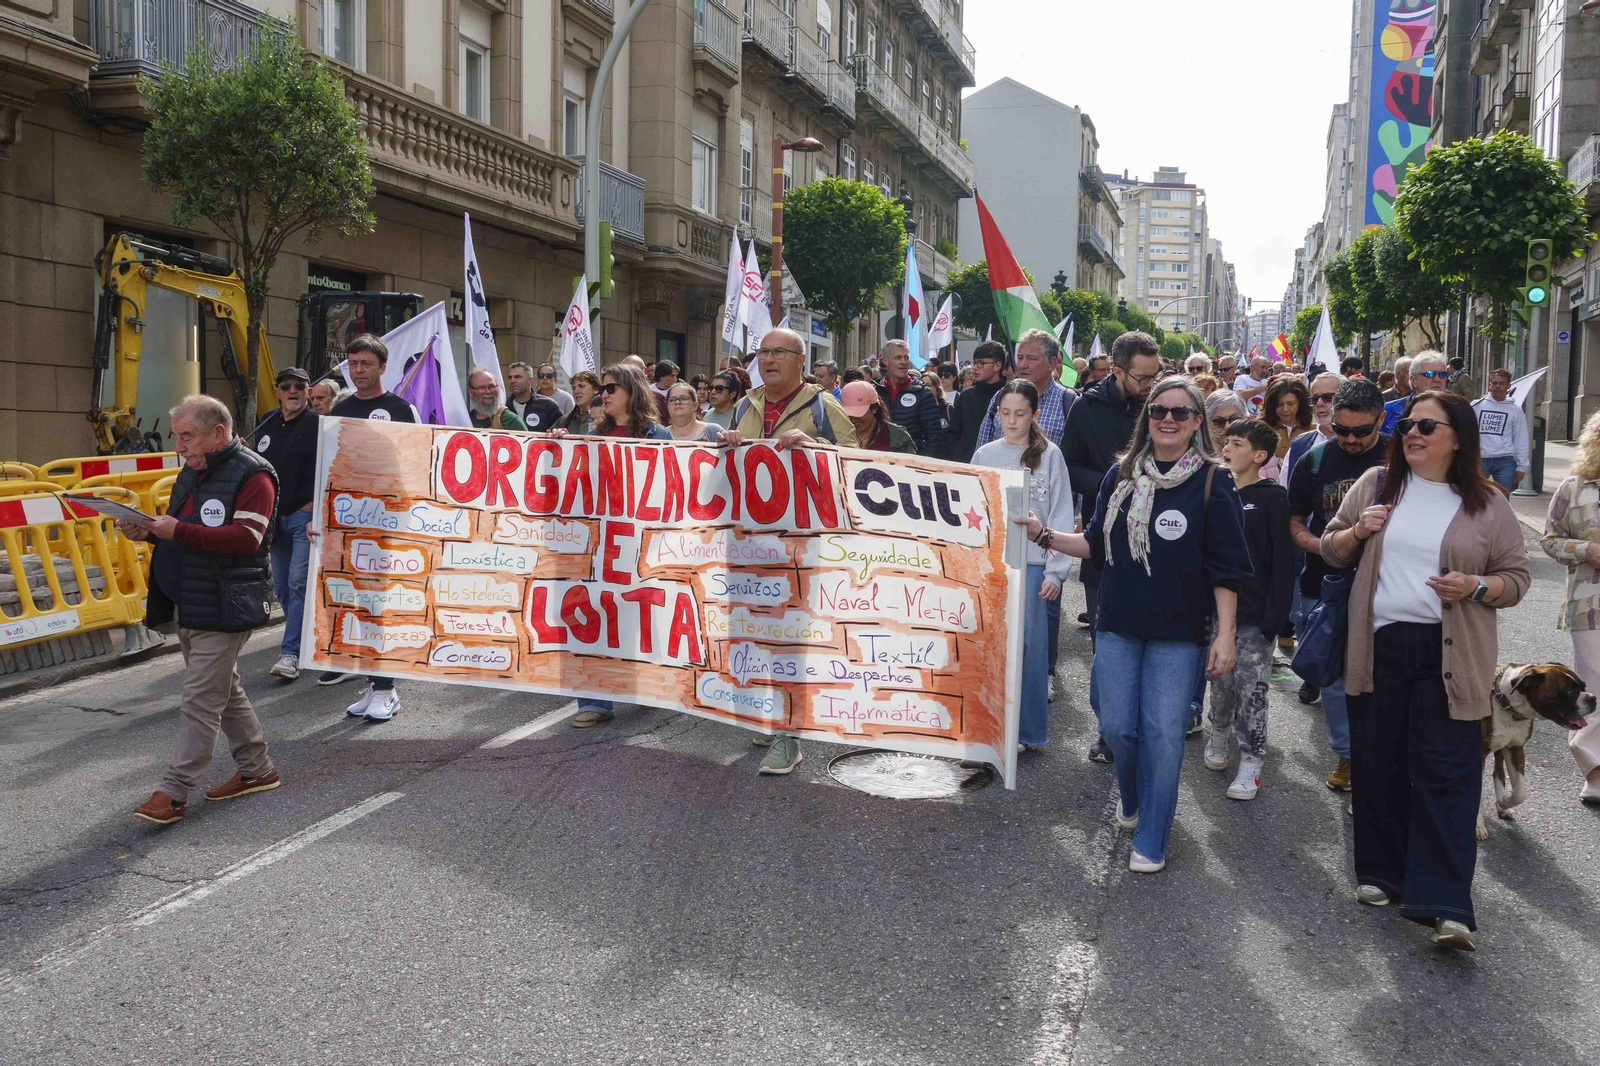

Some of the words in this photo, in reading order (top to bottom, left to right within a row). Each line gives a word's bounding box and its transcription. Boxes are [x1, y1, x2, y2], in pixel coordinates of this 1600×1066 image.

[308, 275, 351, 291] nta4banco
[336, 497, 398, 530] Política
[406, 505, 463, 535] Social
[497, 516, 582, 546] Sanidade
[356, 542, 420, 572] Ensino
[450, 544, 527, 570] Loxística
[604, 521, 635, 585] E
[657, 531, 780, 562] Alimentación
[818, 535, 932, 580] Seguridade
[328, 583, 423, 615] Transportes
[439, 579, 513, 604] Hostelería
[711, 573, 781, 597] Servizos
[820, 580, 880, 612] Naval
[903, 584, 969, 630] Metal
[348, 616, 427, 651] Limpezas
[443, 614, 513, 634] Forestal
[531, 584, 703, 663] LOITA
[708, 610, 824, 639] Restauración
[431, 645, 507, 665] Comercio
[733, 643, 798, 686] Oficinas
[805, 665, 818, 676] e
[828, 659, 914, 693] Despachos
[701, 677, 775, 713] Conserveras
